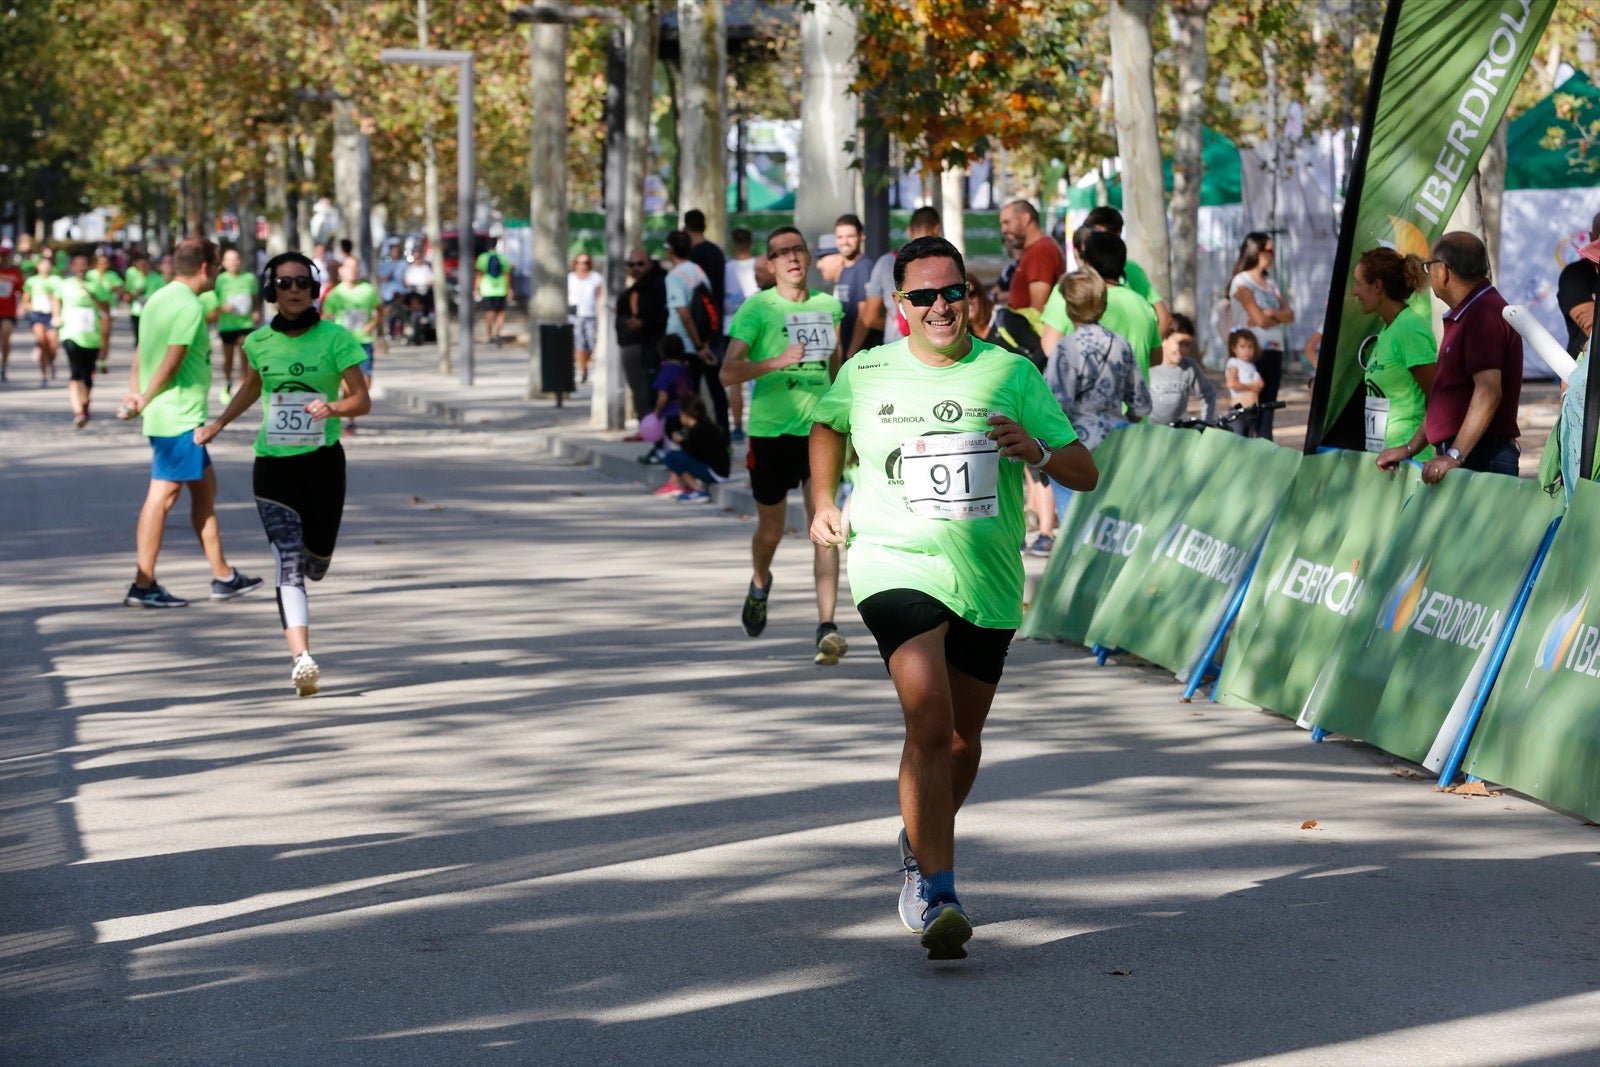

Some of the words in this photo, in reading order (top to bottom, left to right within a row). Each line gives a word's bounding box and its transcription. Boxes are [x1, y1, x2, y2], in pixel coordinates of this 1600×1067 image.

[796, 328, 830, 346] 641
[275, 410, 314, 430] 357
[880, 416, 925, 424] IBERDROLA
[930, 462, 970, 496] 91
